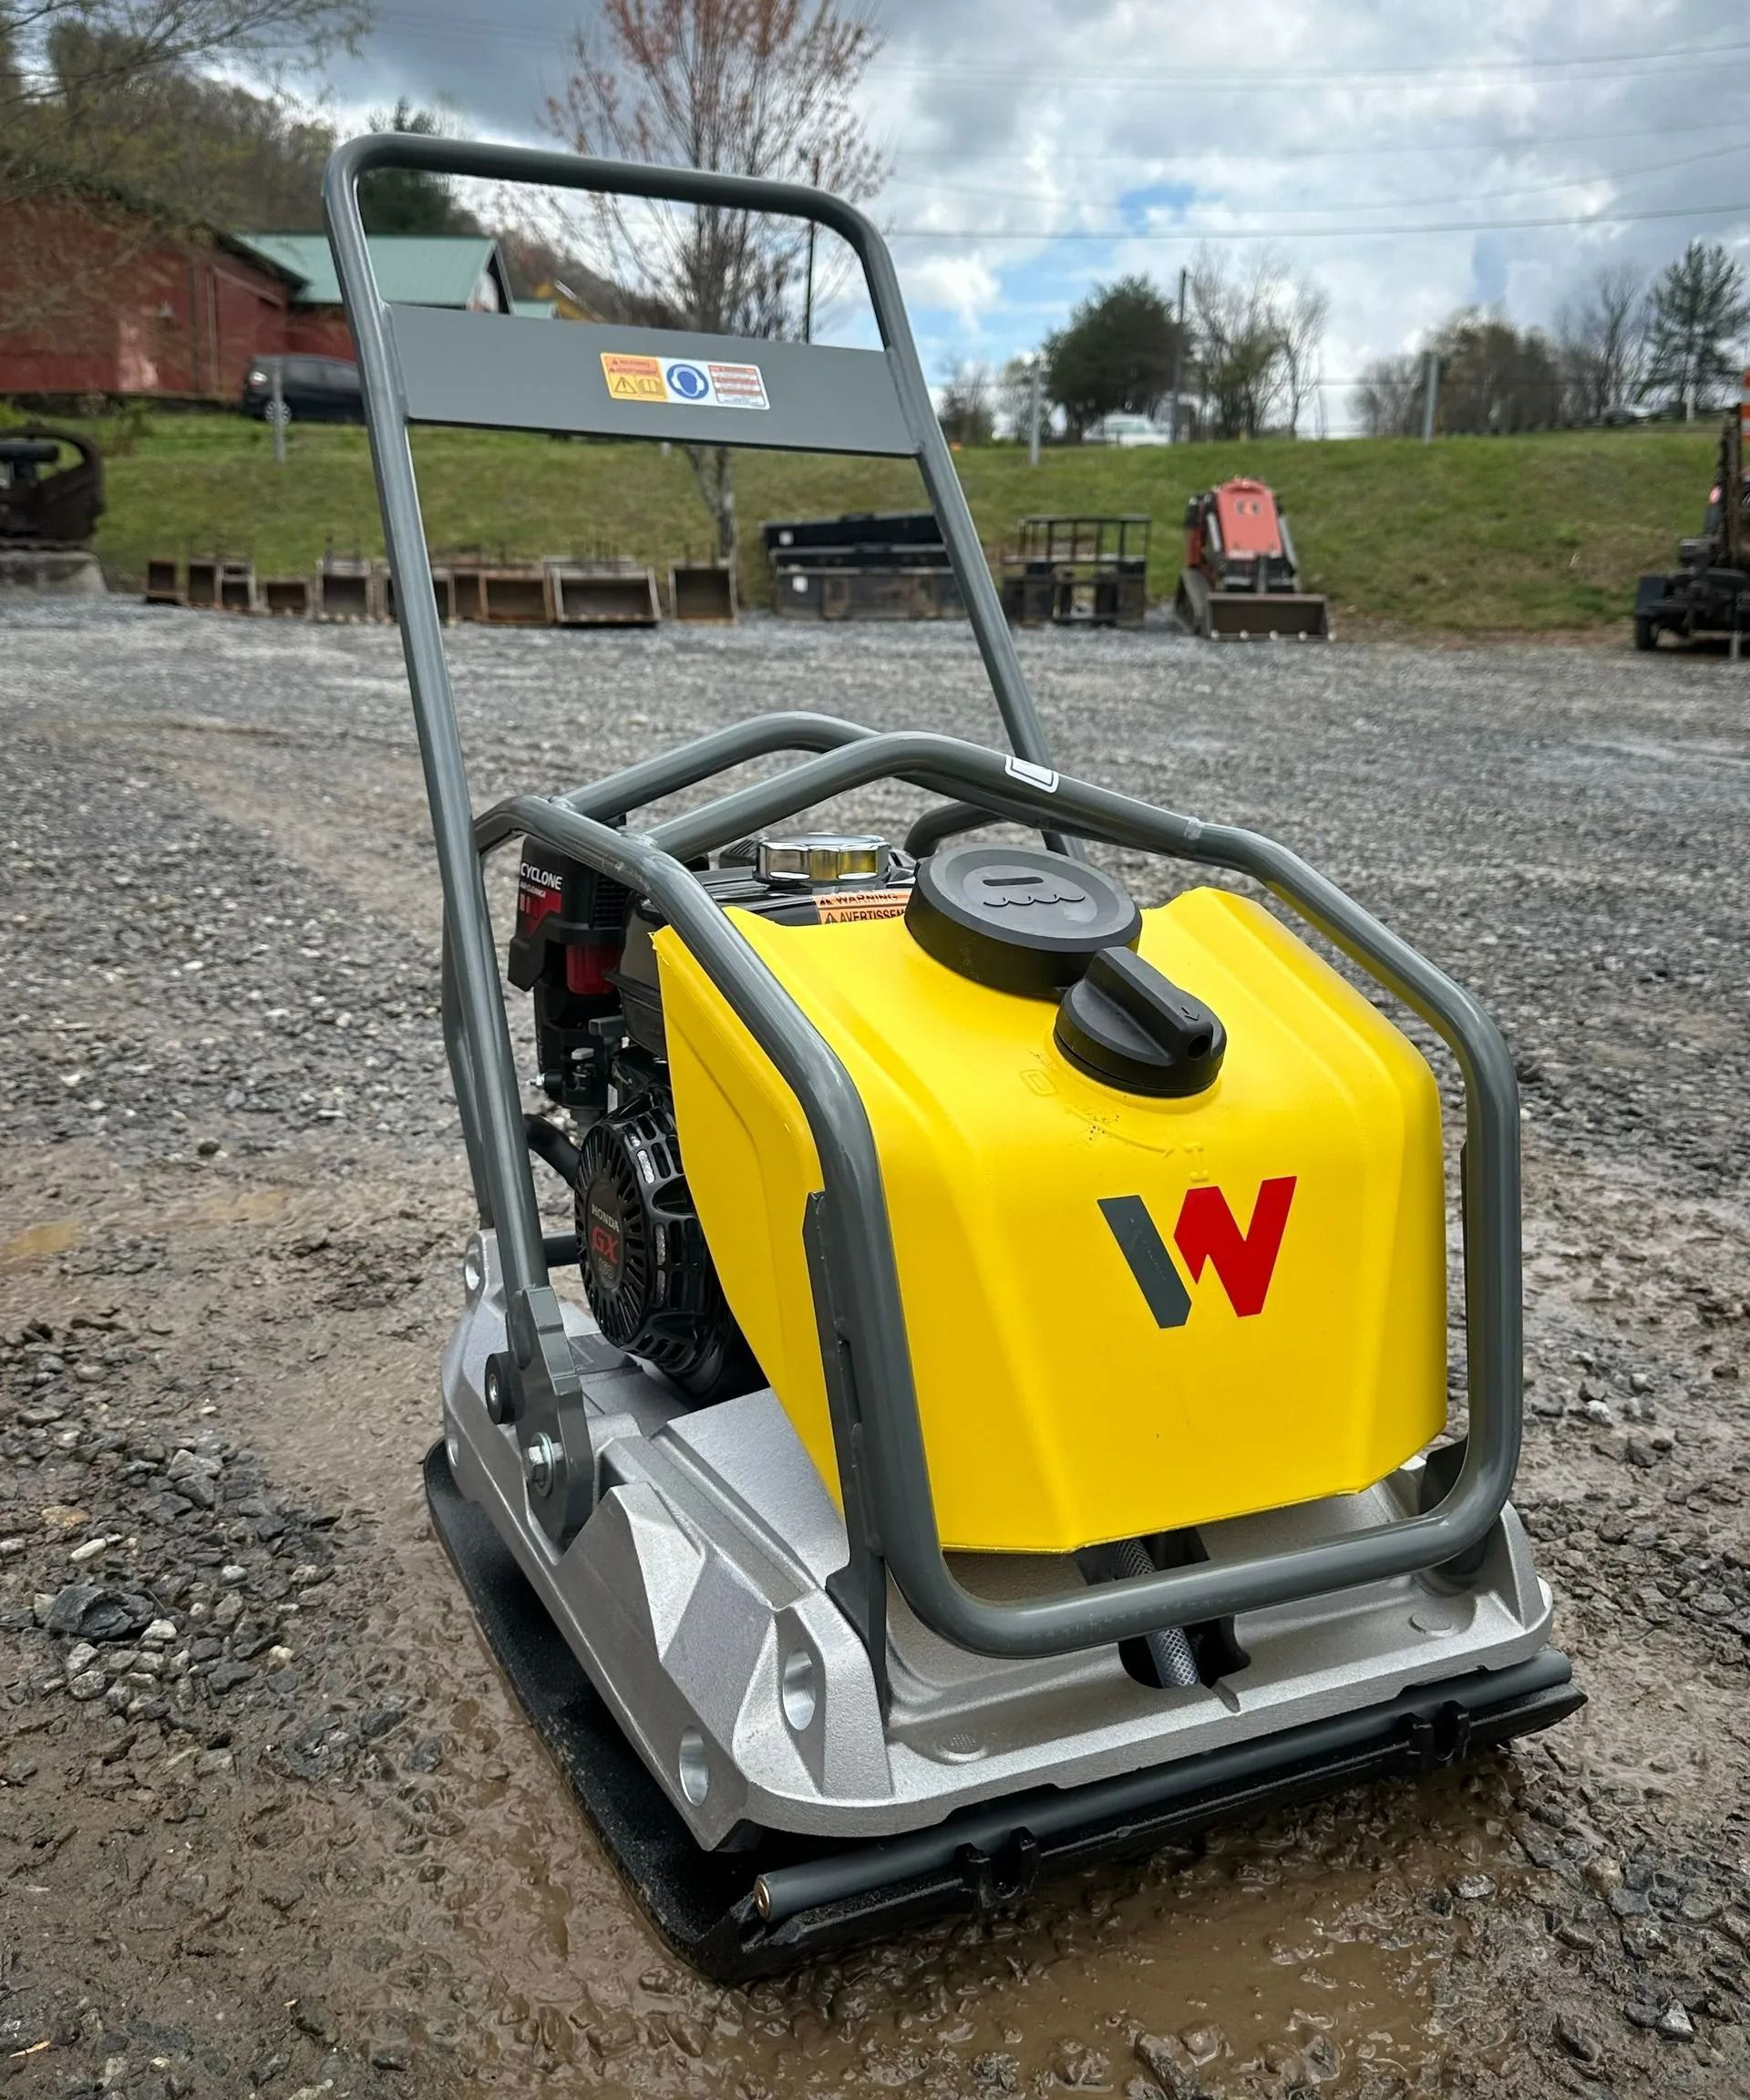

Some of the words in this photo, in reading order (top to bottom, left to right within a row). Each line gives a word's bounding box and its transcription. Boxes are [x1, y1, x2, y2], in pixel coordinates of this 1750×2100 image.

[520, 862, 563, 890] CYCLONE
[592, 1202, 620, 1233] HONDA
[592, 1226, 619, 1264] GX
